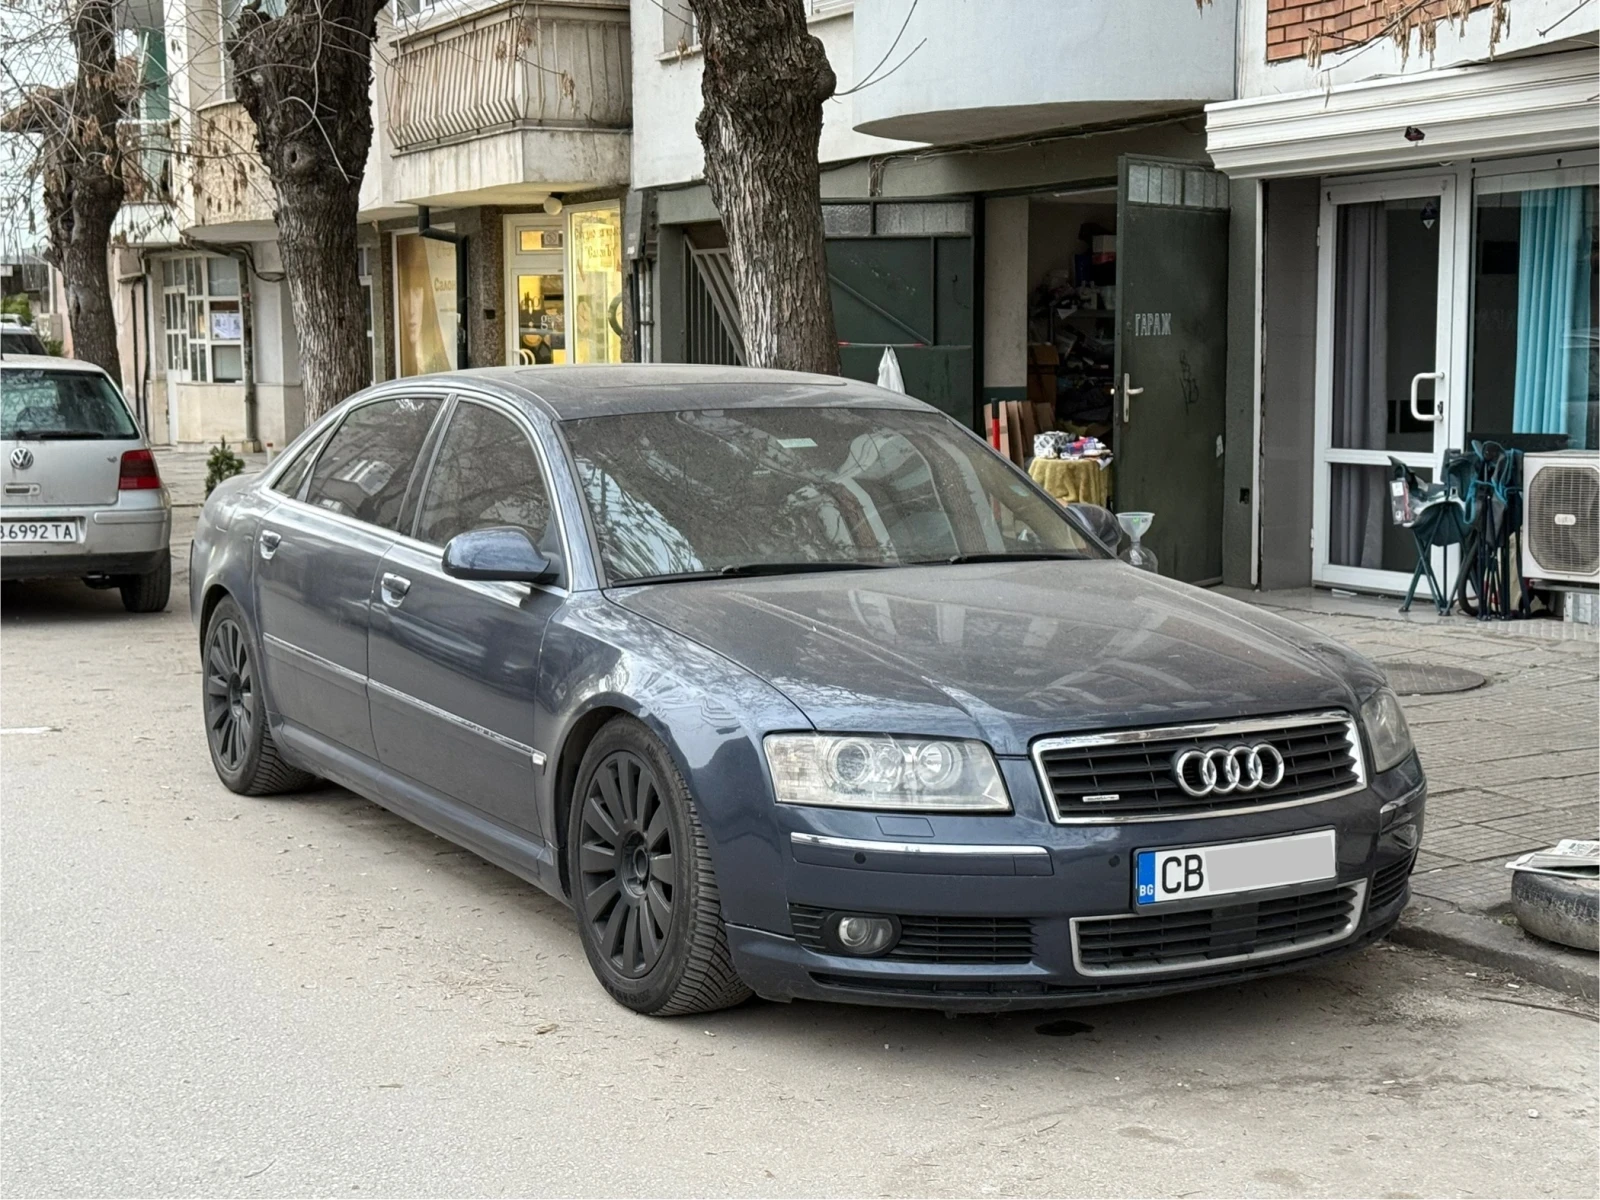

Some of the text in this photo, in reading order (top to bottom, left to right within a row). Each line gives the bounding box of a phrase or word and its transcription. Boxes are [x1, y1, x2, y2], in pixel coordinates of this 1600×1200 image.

[1135, 312, 1172, 337] ГАРАЖ
[8, 524, 49, 540] 6992
[51, 524, 73, 540] TA
[1161, 853, 1205, 895] CB
[1139, 884, 1154, 897] BG
